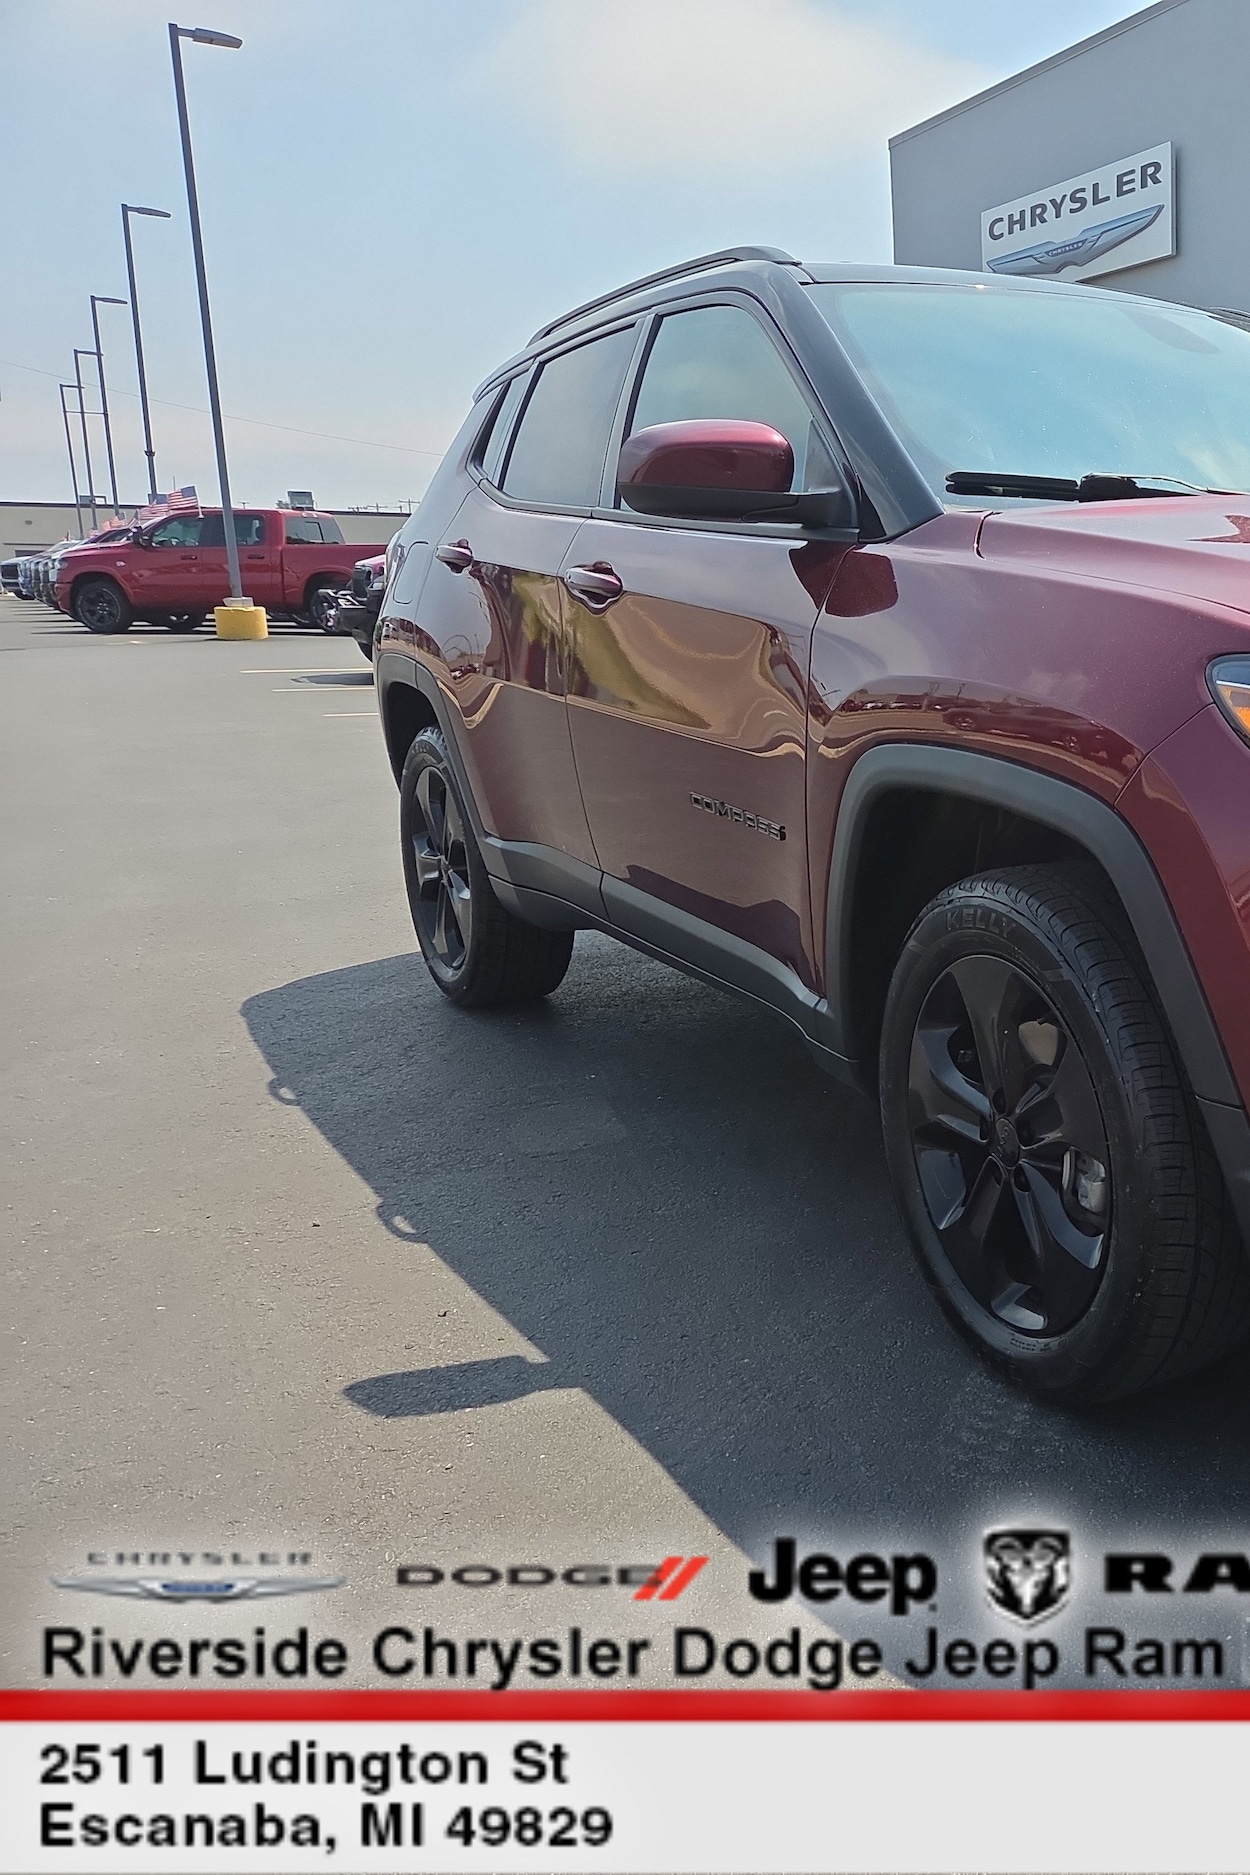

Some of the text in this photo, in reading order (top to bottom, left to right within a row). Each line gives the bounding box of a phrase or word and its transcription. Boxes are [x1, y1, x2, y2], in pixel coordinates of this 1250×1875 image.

[988, 161, 1162, 241] CHRYSLER
[689, 790, 786, 841] COMPASS
[946, 908, 1016, 938] KELLY
